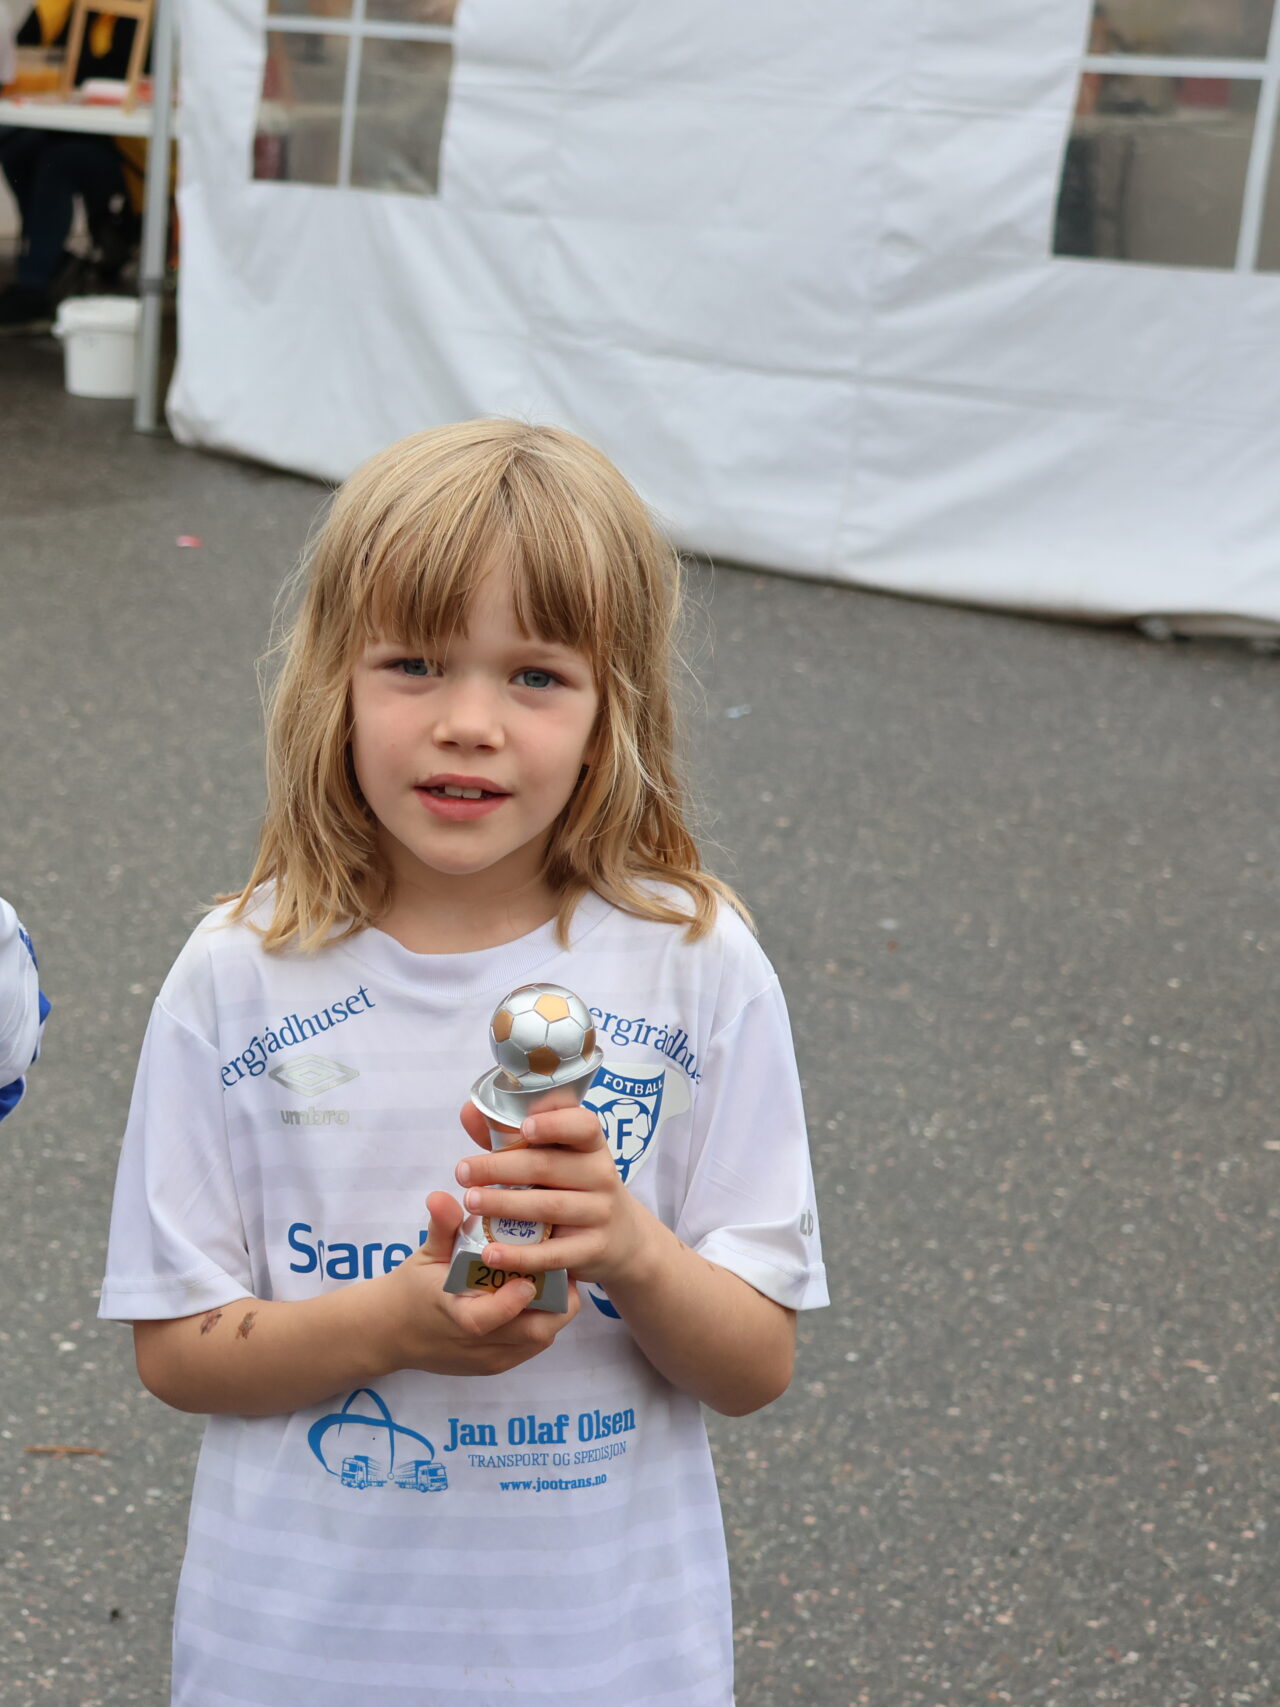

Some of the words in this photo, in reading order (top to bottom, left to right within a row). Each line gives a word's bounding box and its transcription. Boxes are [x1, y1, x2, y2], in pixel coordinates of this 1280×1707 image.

[603, 1073, 664, 1096] FOTBALL
[616, 1118, 633, 1150] F
[443, 1417, 498, 1452] Jan
[508, 1414, 570, 1446] Olaf
[578, 1407, 636, 1442] Olsen
[468, 1454, 549, 1469] TRANSPORT
[553, 1453, 570, 1467] OG
[573, 1441, 627, 1465] SPEDISJON
[499, 1473, 607, 1492] www.jootrans.no
